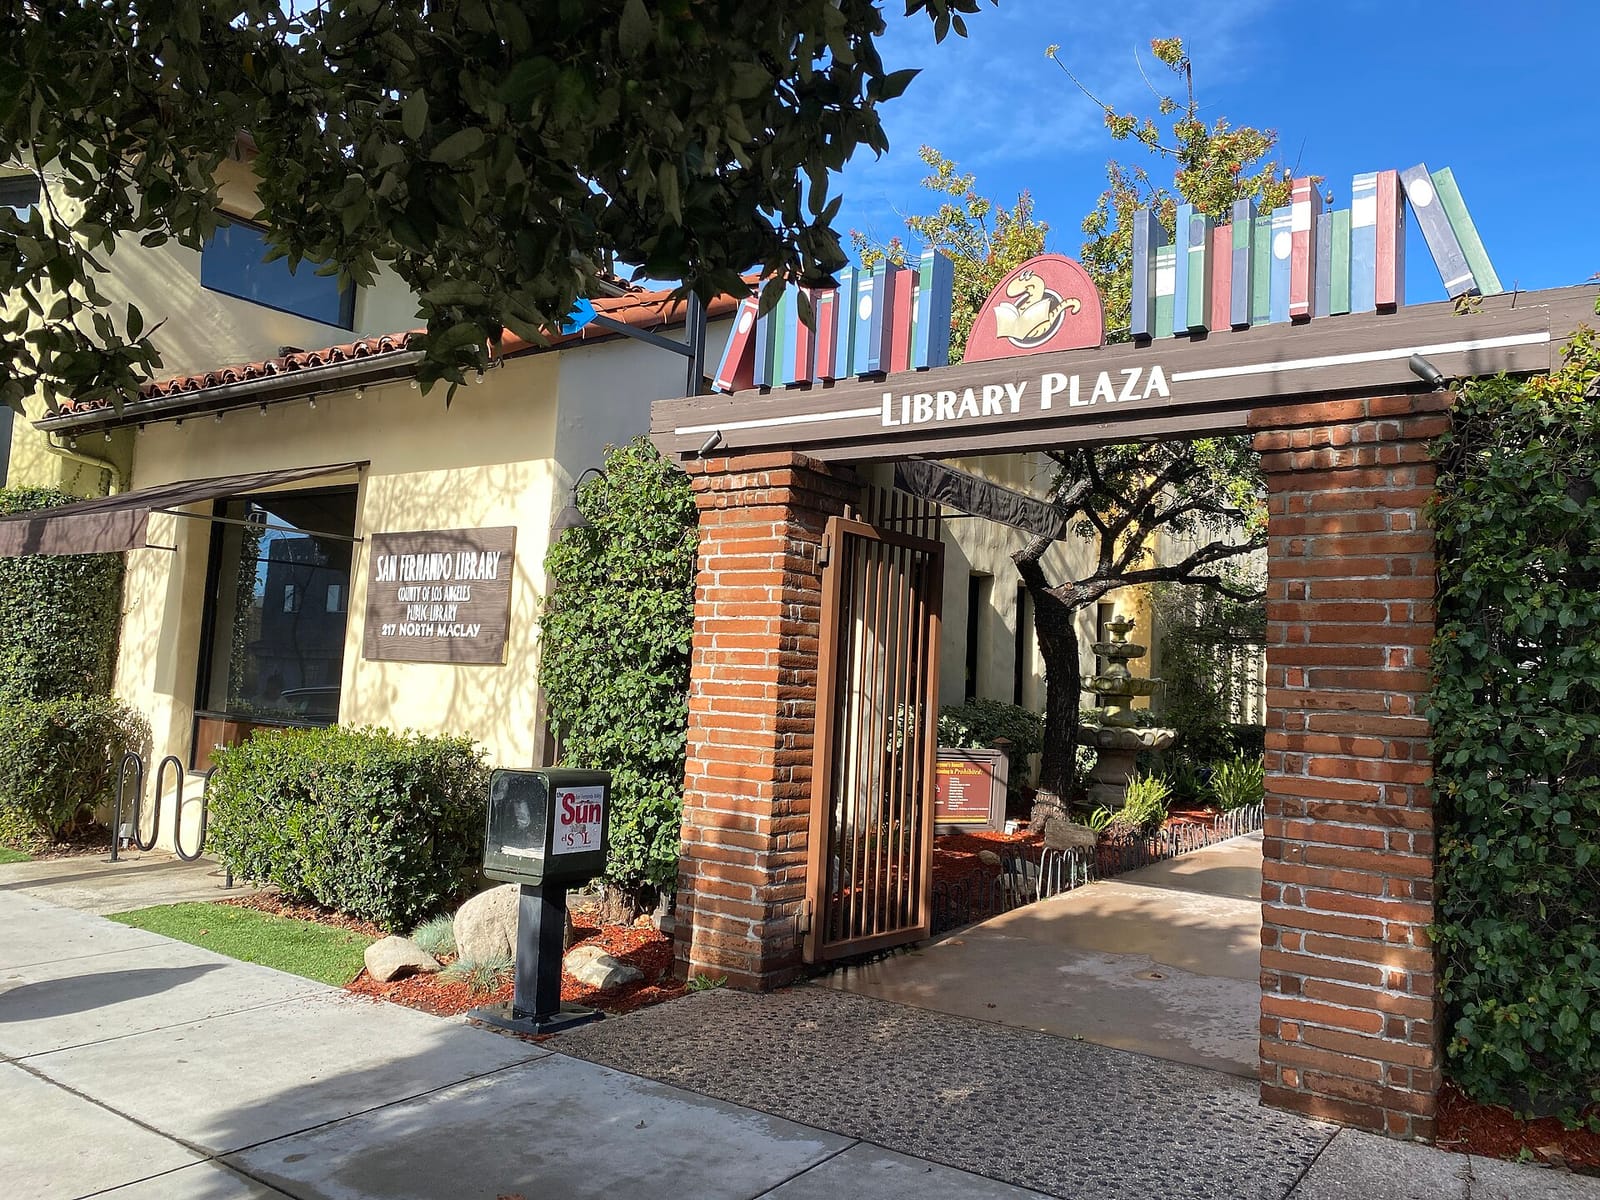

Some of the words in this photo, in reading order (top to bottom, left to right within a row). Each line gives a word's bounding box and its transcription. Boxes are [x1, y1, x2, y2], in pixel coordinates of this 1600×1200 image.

[881, 381, 1029, 427] LIBRARY
[1040, 365, 1170, 410] PLAZA
[375, 554, 398, 582] SAN
[399, 552, 453, 581] FERNANDO
[455, 551, 501, 581] LIBRARY
[397, 586, 422, 602] COUNTY
[422, 586, 431, 602] OF
[431, 585, 443, 602] LOS
[443, 585, 472, 602] ANGELES
[406, 604, 428, 622] PUBLIC
[429, 604, 458, 622] LIBRARY
[381, 623, 397, 636] 217
[399, 623, 434, 637] NORTH
[436, 623, 481, 638] MACLAY
[561, 792, 602, 826] Sun
